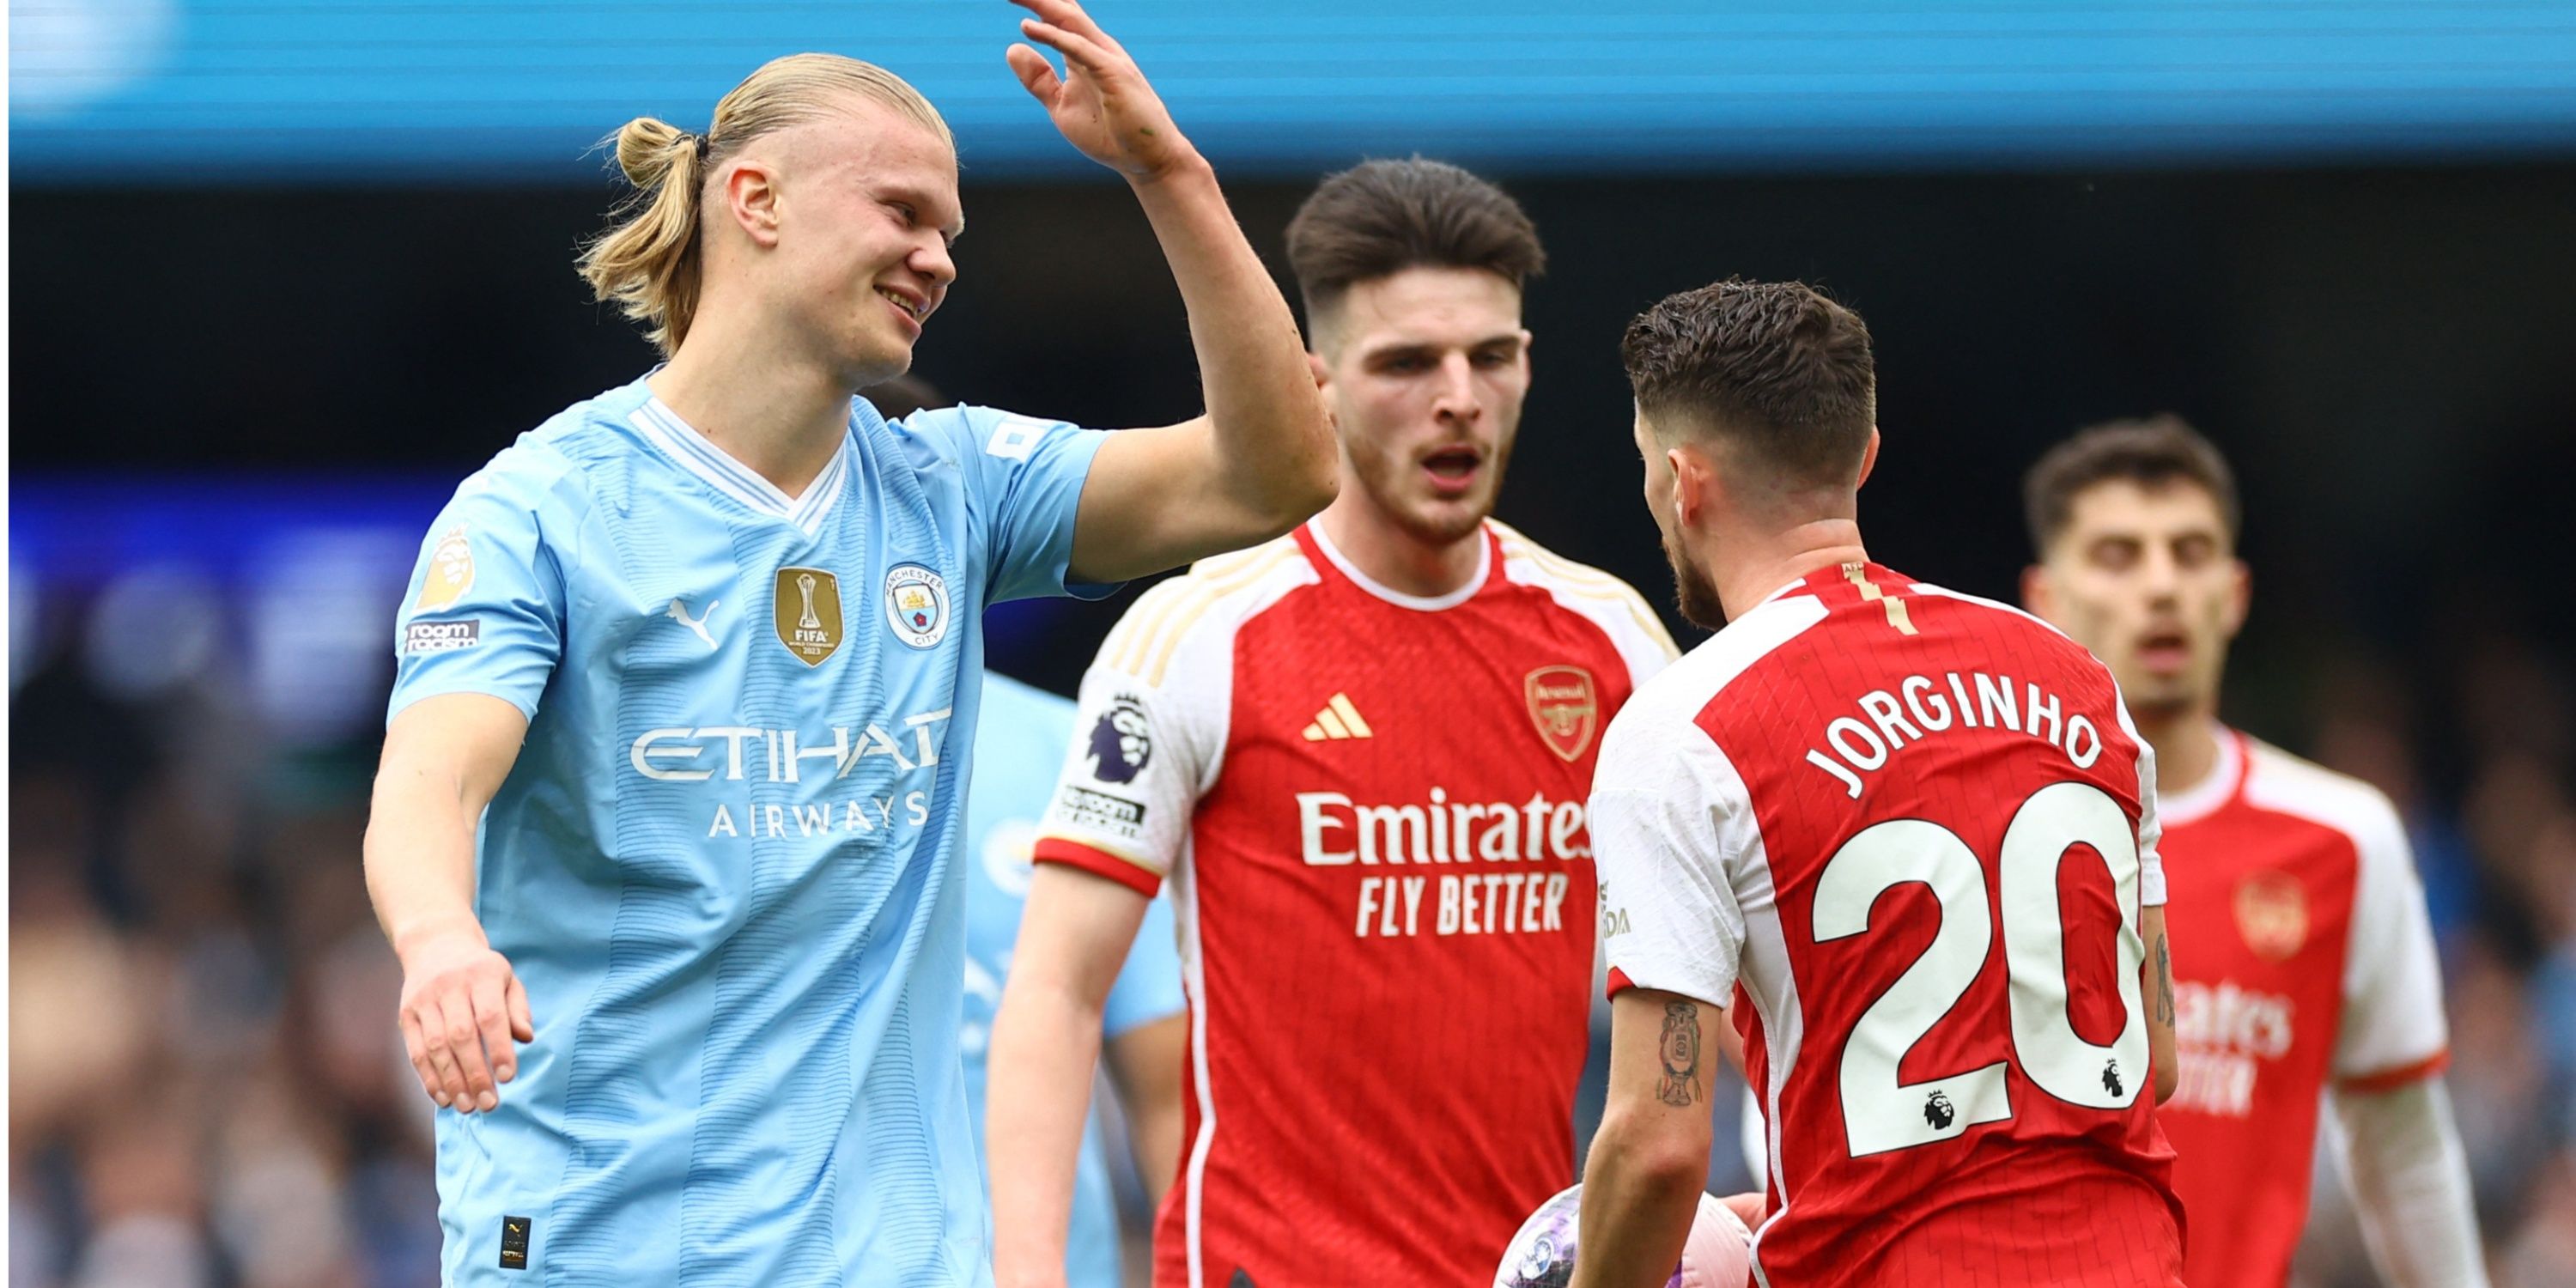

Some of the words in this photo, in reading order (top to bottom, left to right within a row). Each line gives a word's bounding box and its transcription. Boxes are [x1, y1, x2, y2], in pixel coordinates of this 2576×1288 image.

[885, 569, 943, 596] MANCHESTER
[410, 624, 469, 638] room
[795, 629, 827, 642] FIFA
[914, 634, 939, 645] CITY
[1806, 672, 2103, 800] JORGINHO
[708, 791, 928, 838] AIRWAYS
[1355, 875, 1426, 939] FLY
[1437, 871, 1571, 936] BETTER
[1812, 781, 2150, 1157] 20
